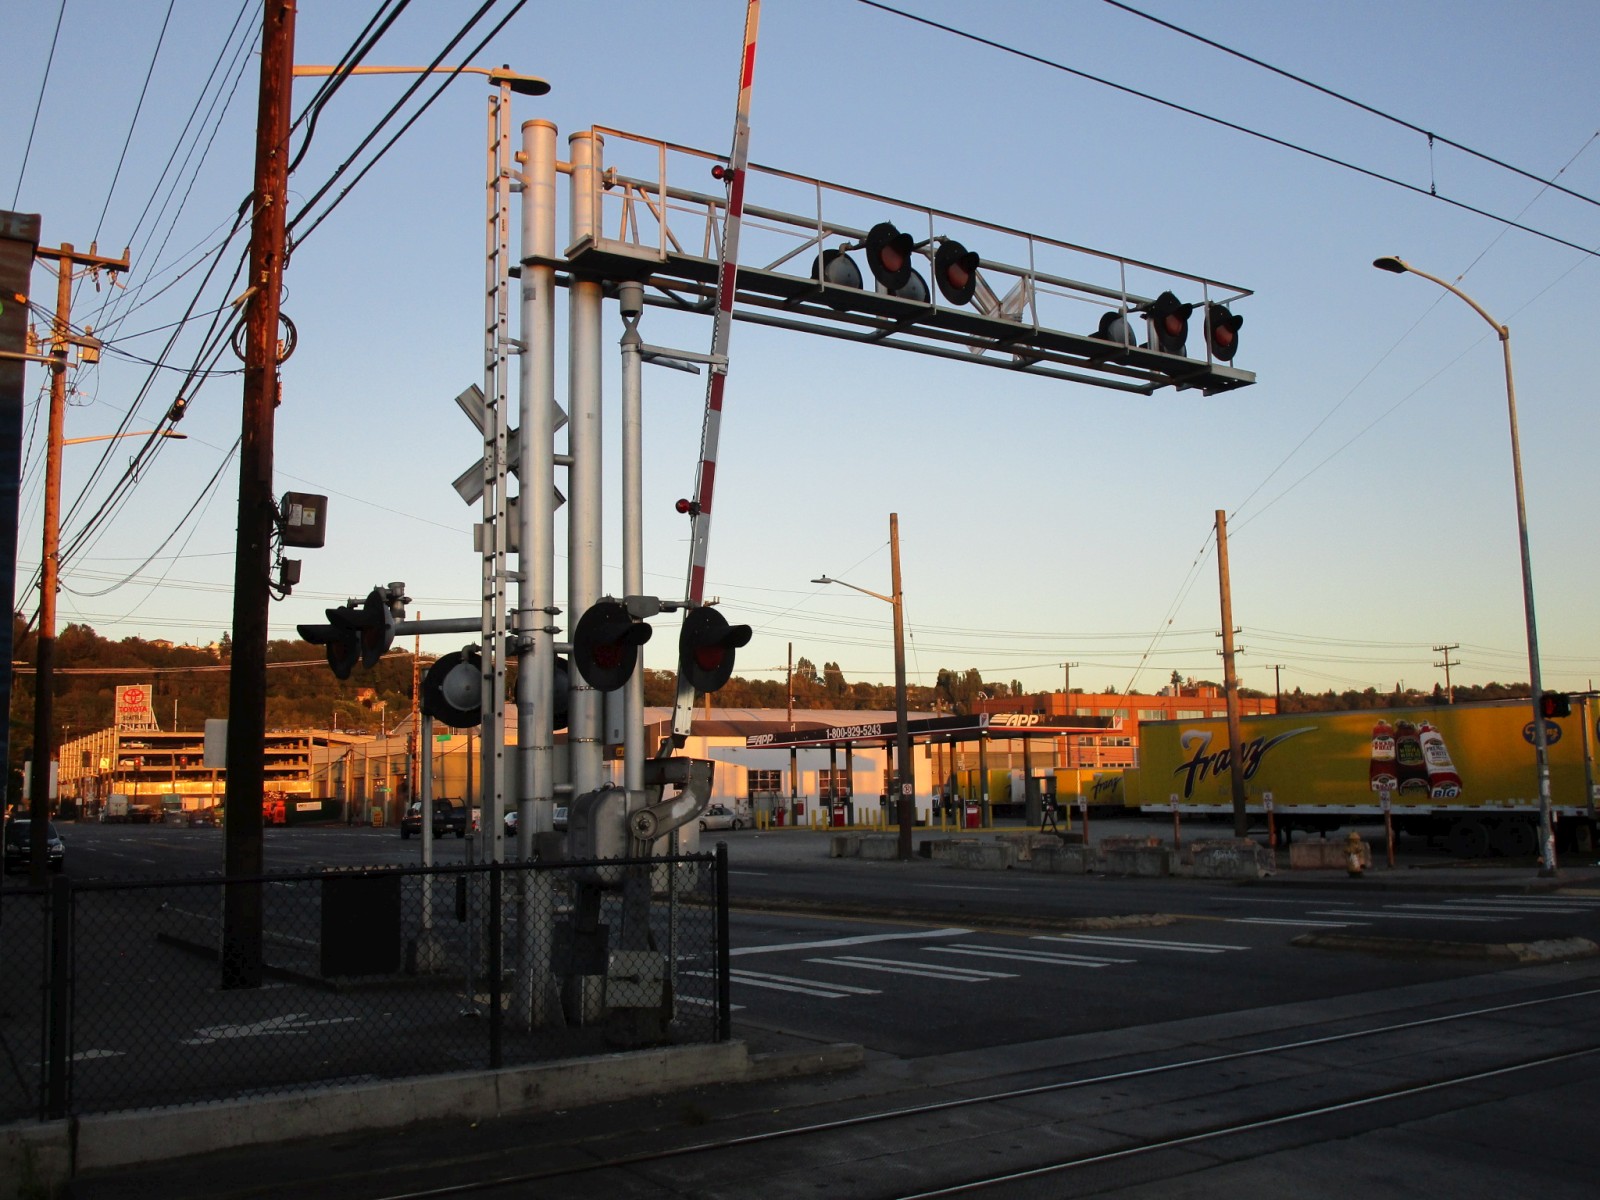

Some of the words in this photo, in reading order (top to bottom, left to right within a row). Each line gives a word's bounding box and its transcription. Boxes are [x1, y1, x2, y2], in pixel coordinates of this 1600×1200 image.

[1006, 714, 1039, 726] APP
[826, 723, 882, 739] 1-800-929-5243
[755, 734, 774, 745] APP
[1433, 789, 1456, 798] BIG
